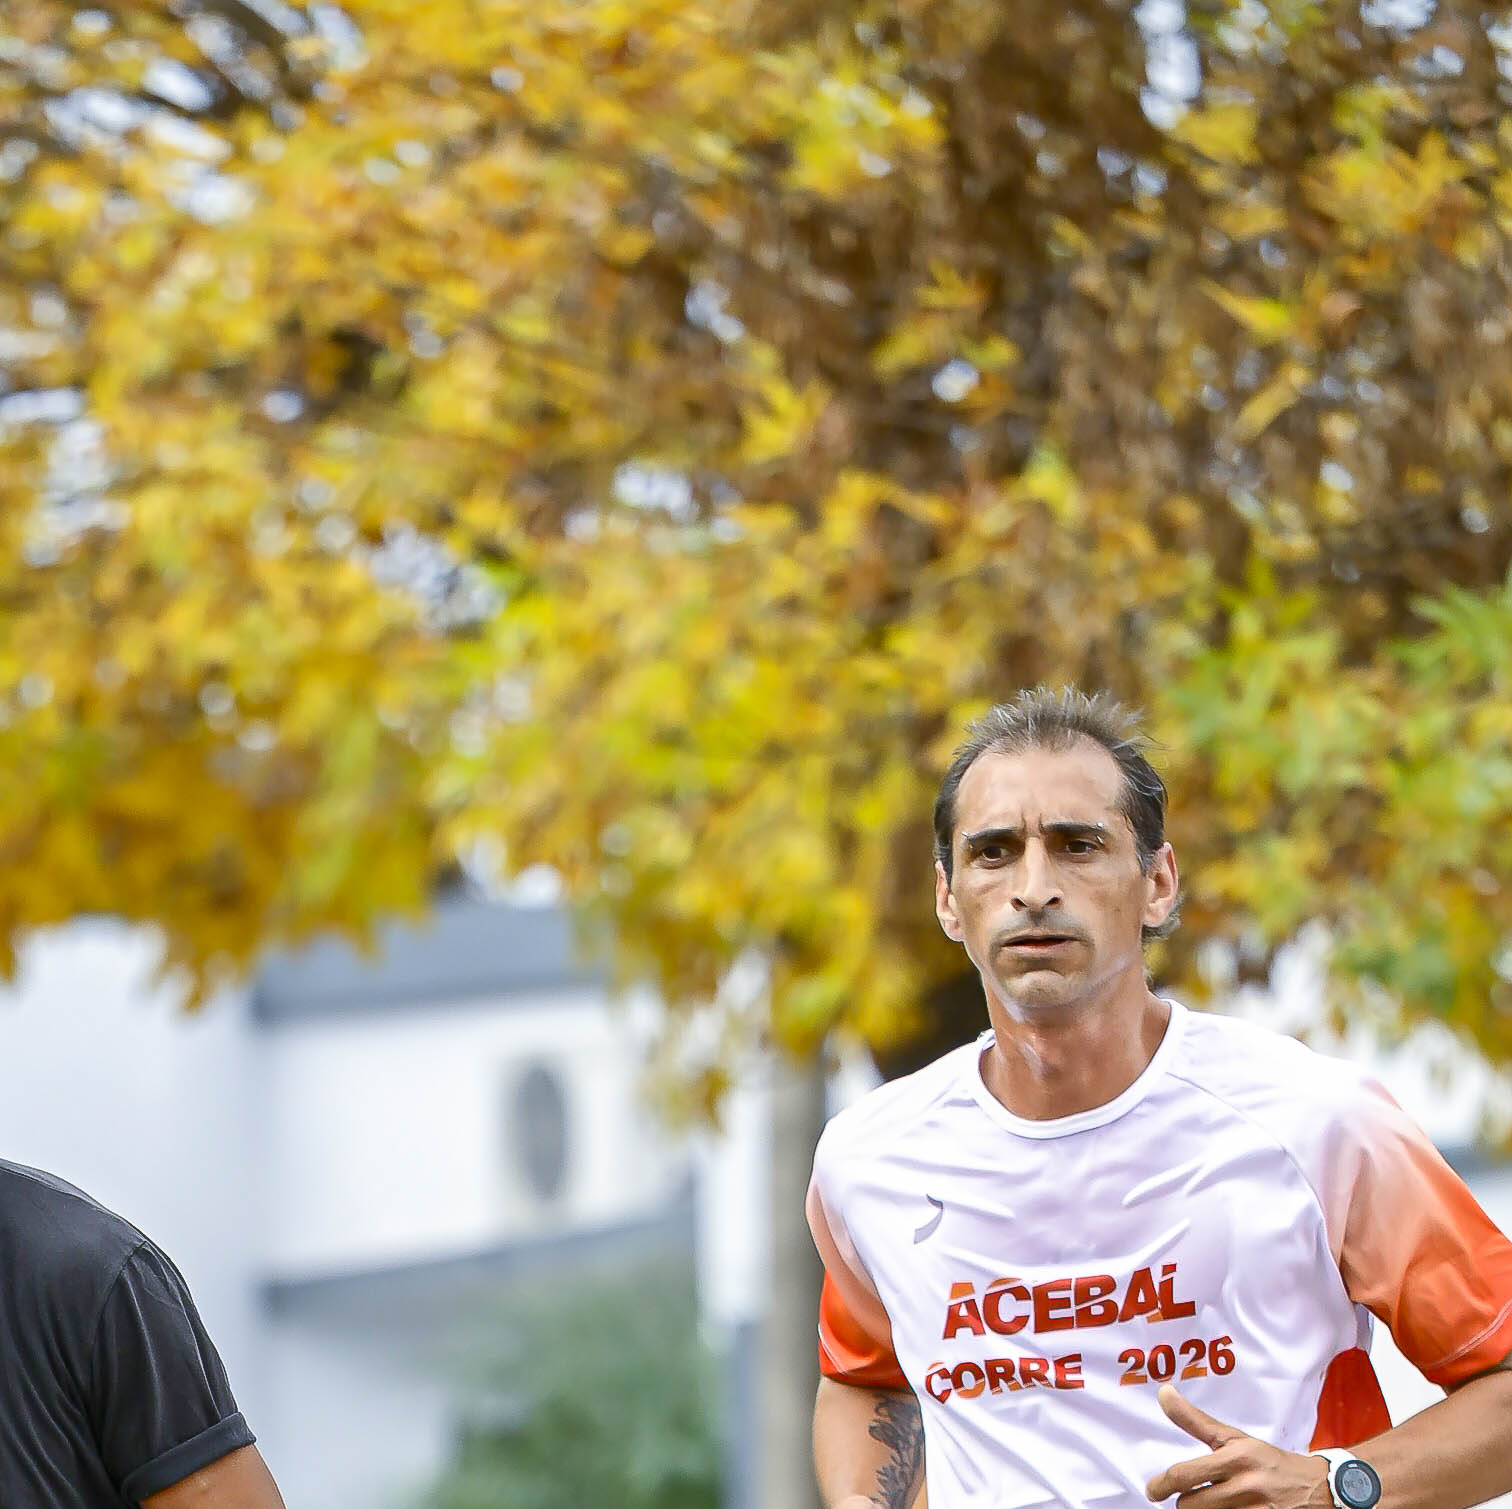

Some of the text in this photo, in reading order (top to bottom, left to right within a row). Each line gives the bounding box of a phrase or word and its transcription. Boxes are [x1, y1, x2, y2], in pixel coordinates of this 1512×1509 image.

[942, 1263, 1197, 1340] ACEBAL
[924, 1335, 1236, 1404] CORRE 2026
